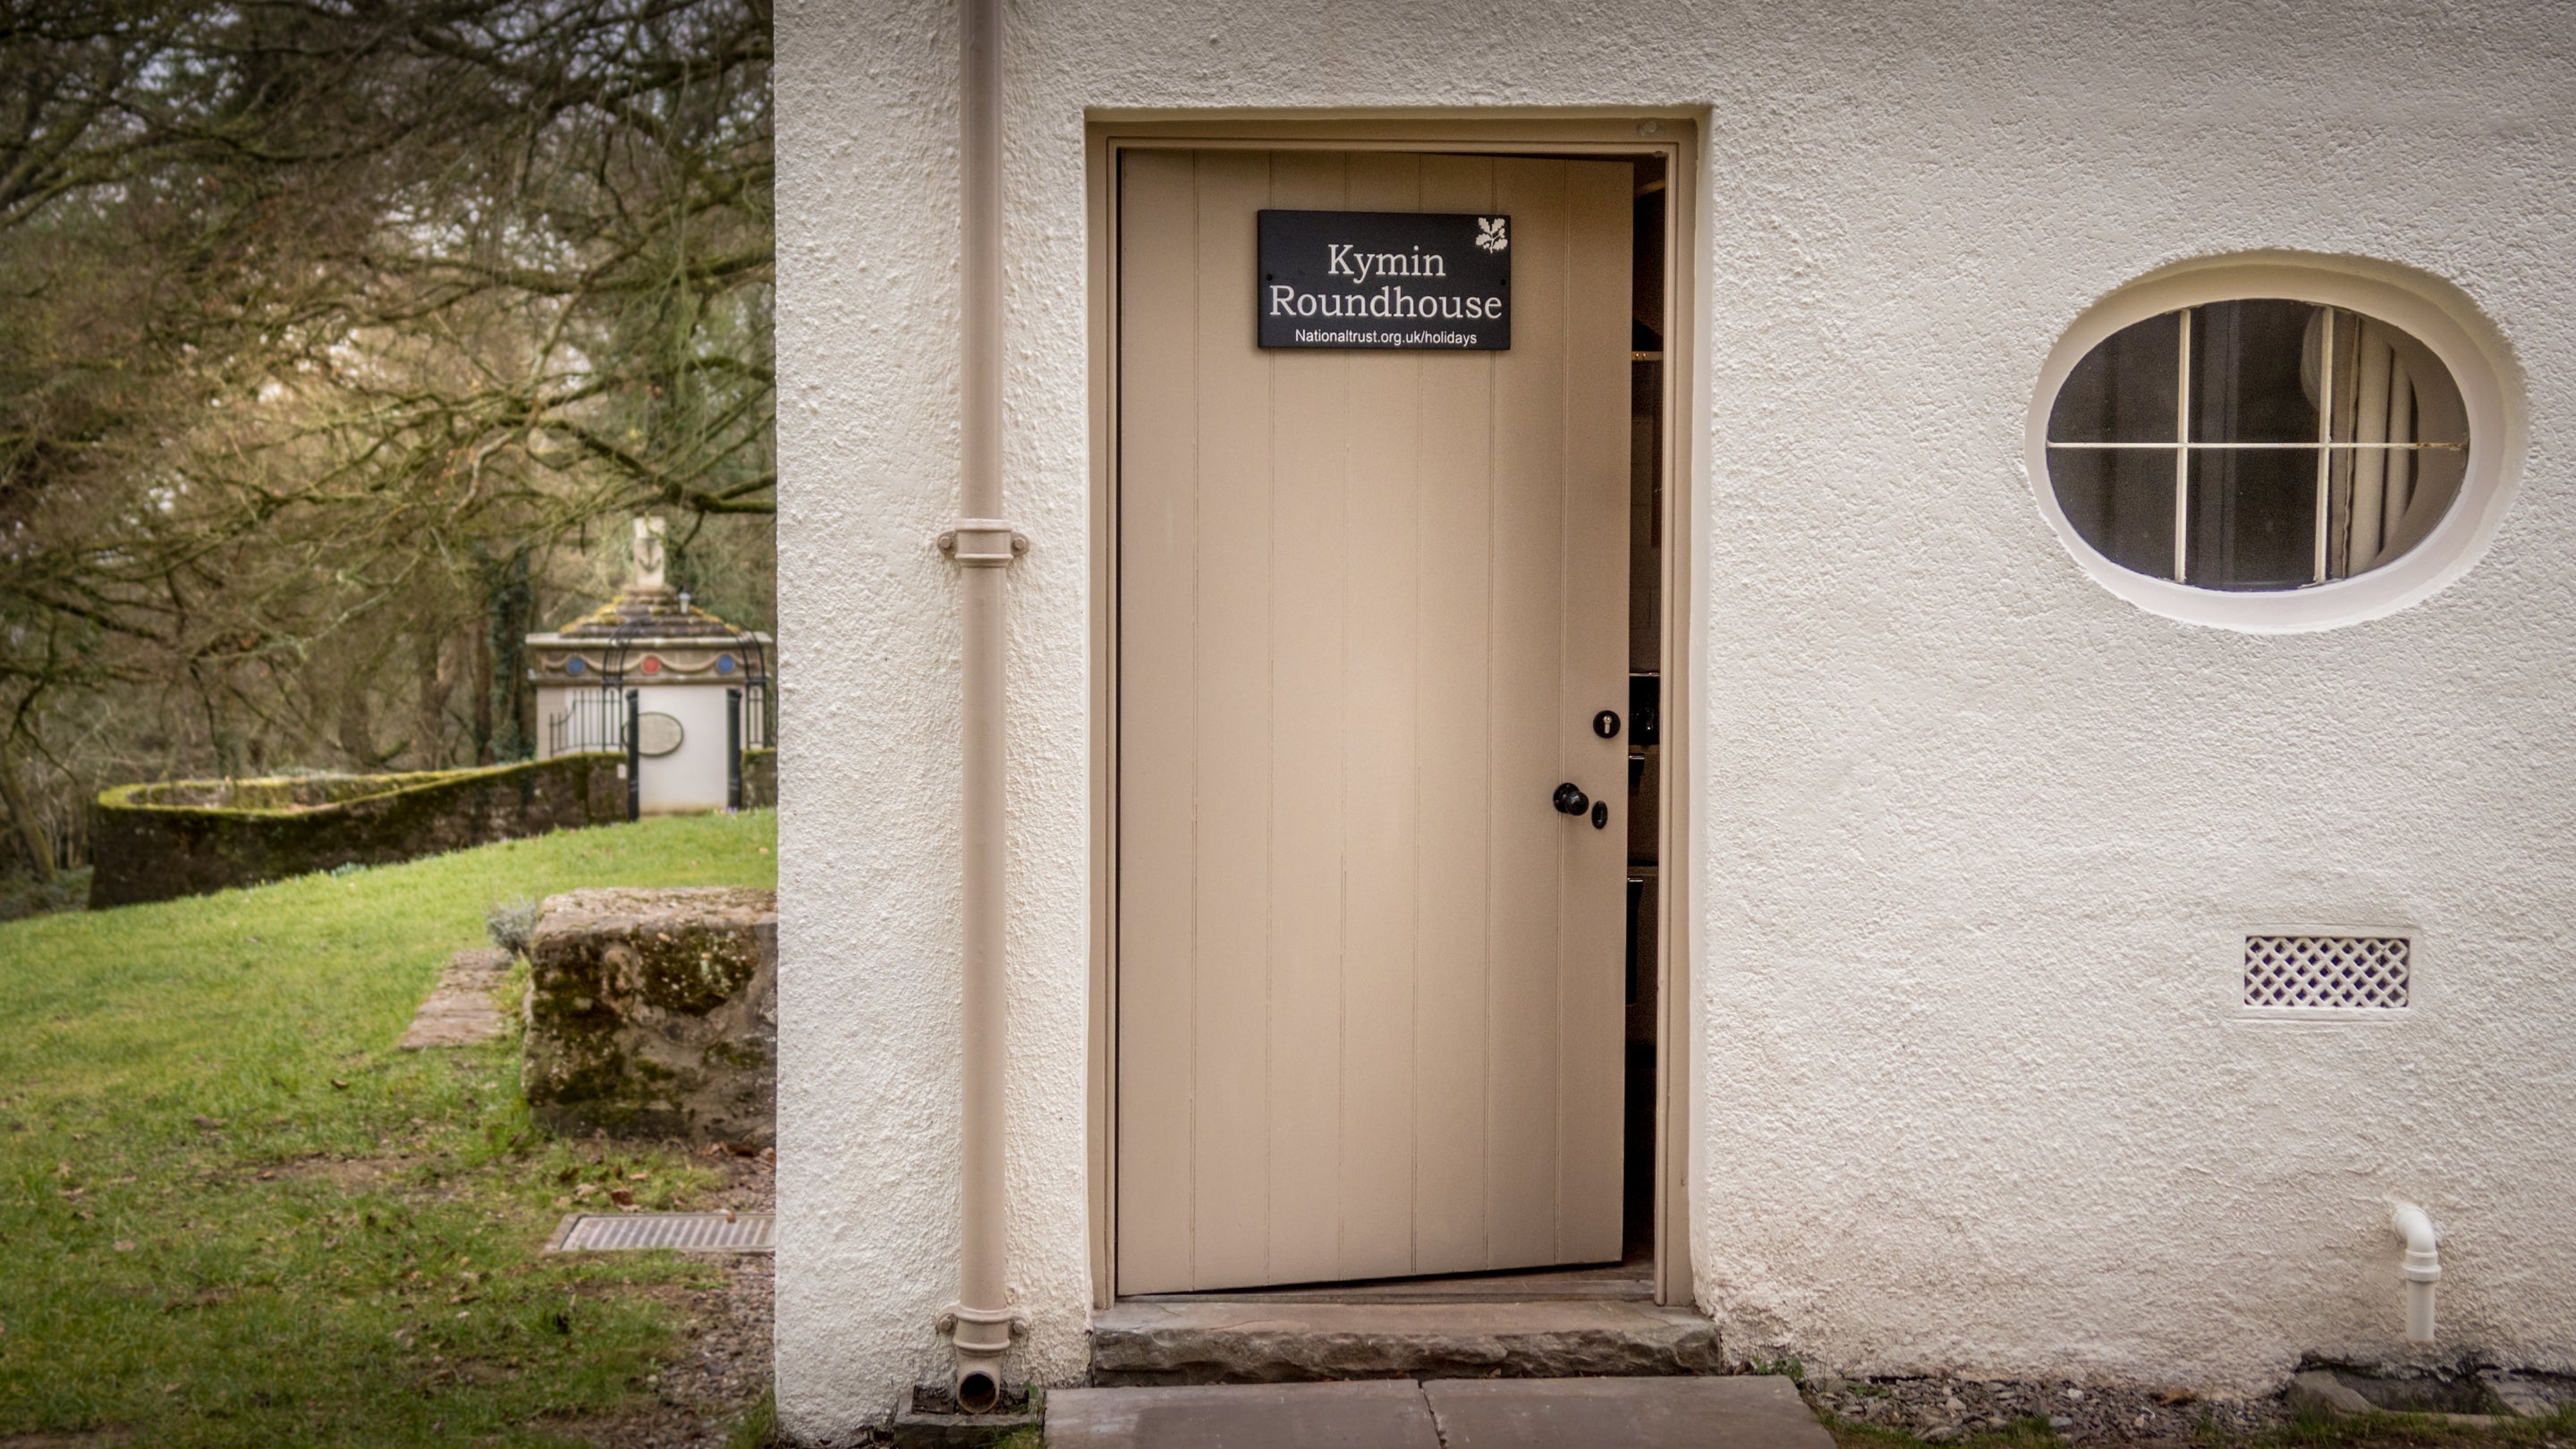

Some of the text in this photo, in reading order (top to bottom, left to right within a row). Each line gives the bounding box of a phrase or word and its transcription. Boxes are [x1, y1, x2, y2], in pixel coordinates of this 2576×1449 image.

[1327, 243, 1446, 284] Kymin
[1269, 284, 1503, 319] Roundhouse
[1295, 328, 1478, 347] Nationaltrust.org.uk/holidays
